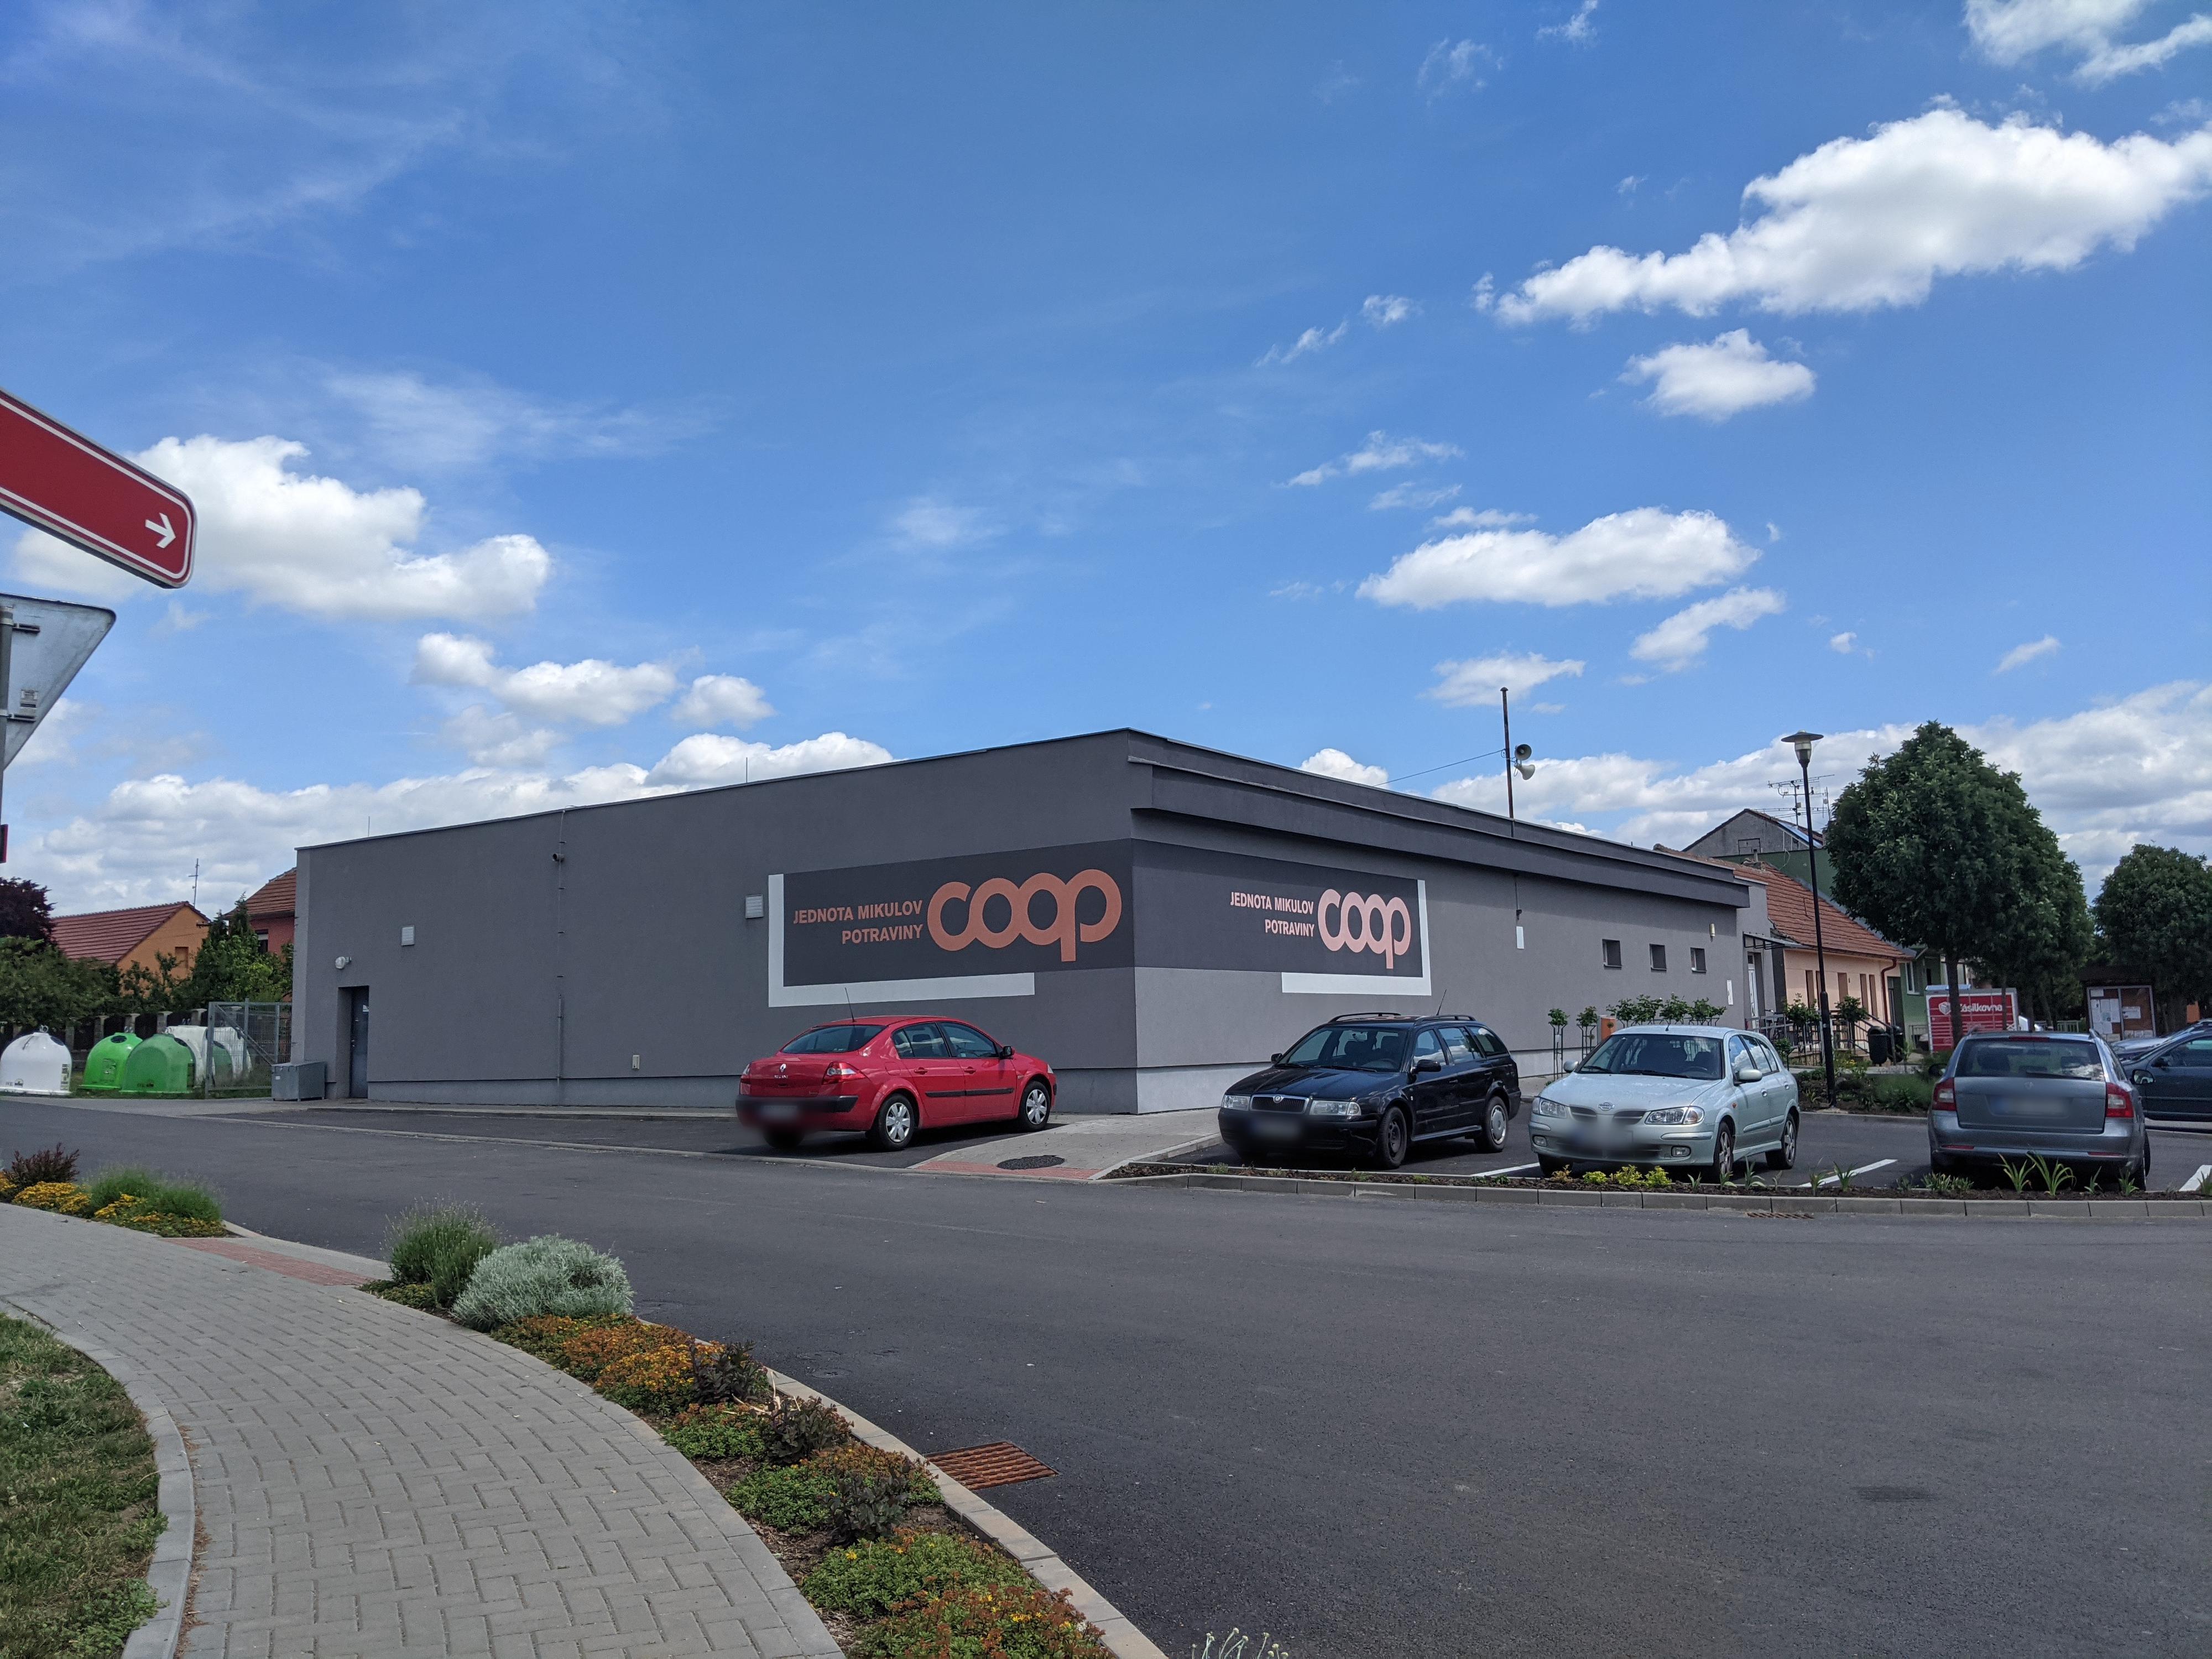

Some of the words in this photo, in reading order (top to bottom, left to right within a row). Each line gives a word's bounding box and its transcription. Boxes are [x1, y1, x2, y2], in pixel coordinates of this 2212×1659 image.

[793, 907, 854, 924] JEDNOTA
[858, 900, 922, 920] MIKULOV
[1230, 891, 1272, 910] JEDNOTA
[1274, 897, 1314, 915] MIKULOV
[842, 924, 923, 945] POTRAVINY
[1265, 919, 1315, 937] POTRAVINY
